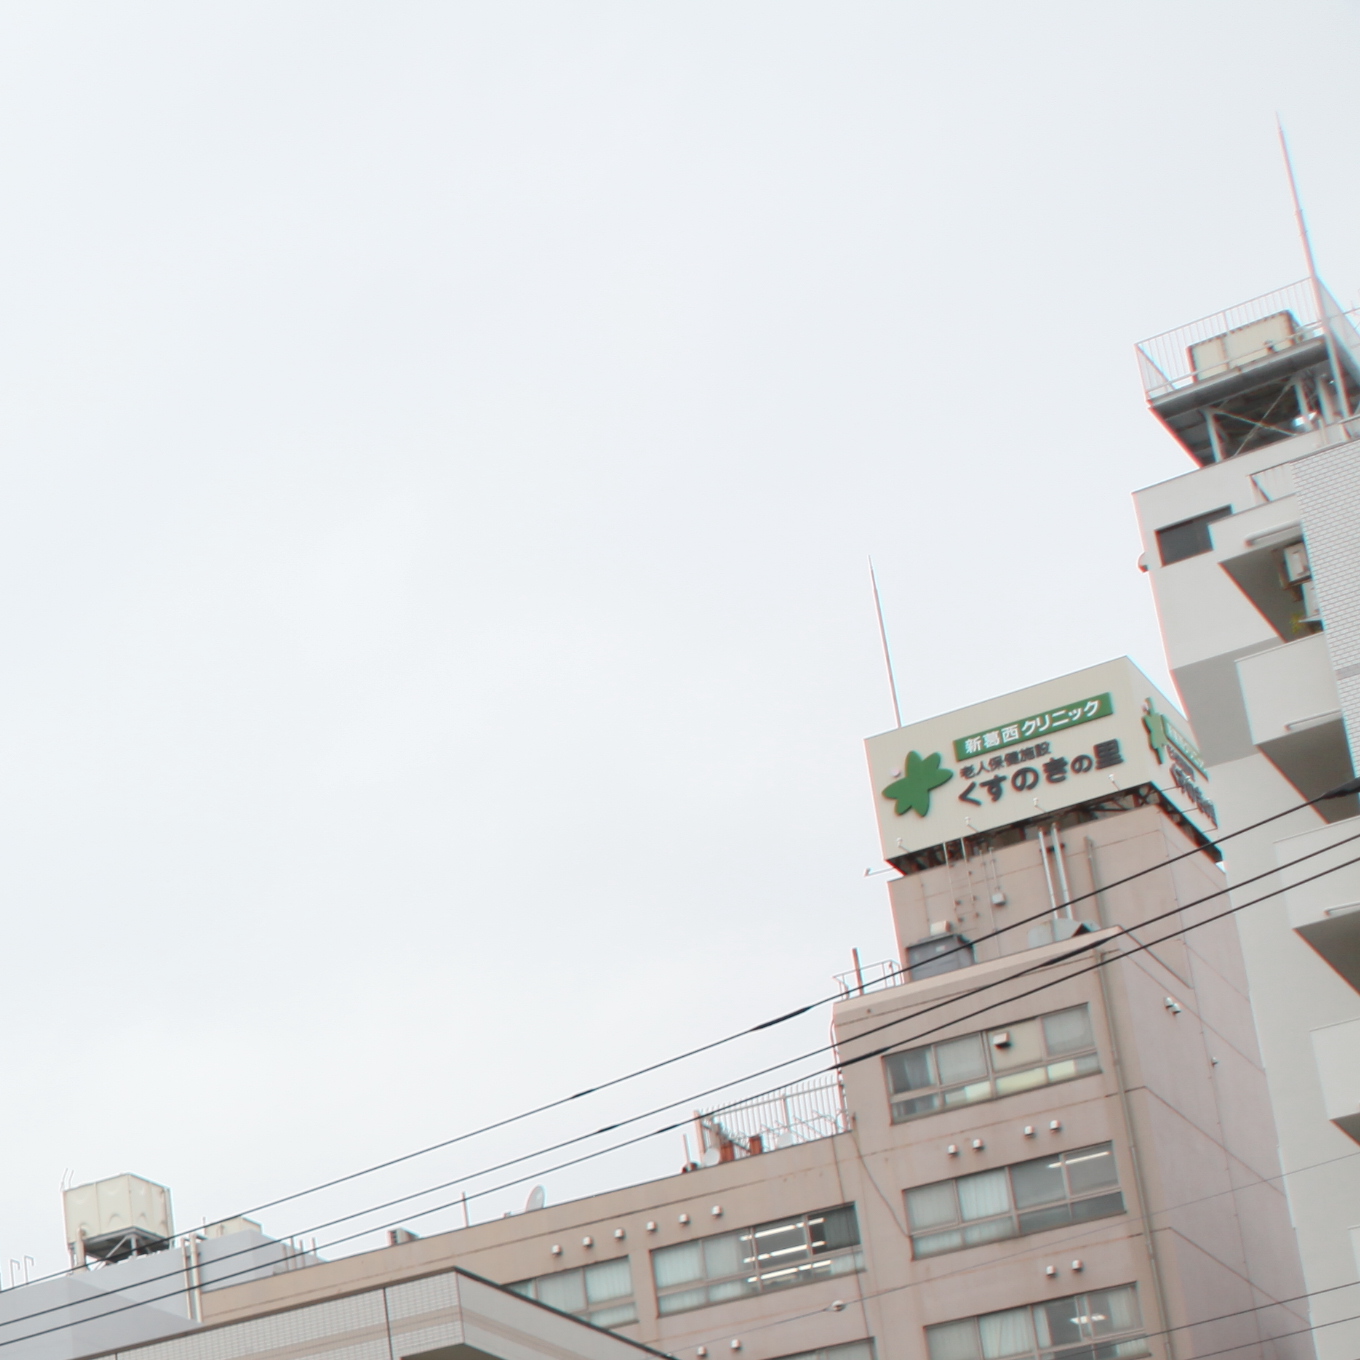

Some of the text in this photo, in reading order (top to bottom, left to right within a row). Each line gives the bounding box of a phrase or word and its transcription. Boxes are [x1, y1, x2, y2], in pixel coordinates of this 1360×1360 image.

[964, 700, 1100, 754] 新葛西クリニック
[958, 738, 1124, 806] くすのきの里
[960, 741, 1052, 779] 老人保健施設
